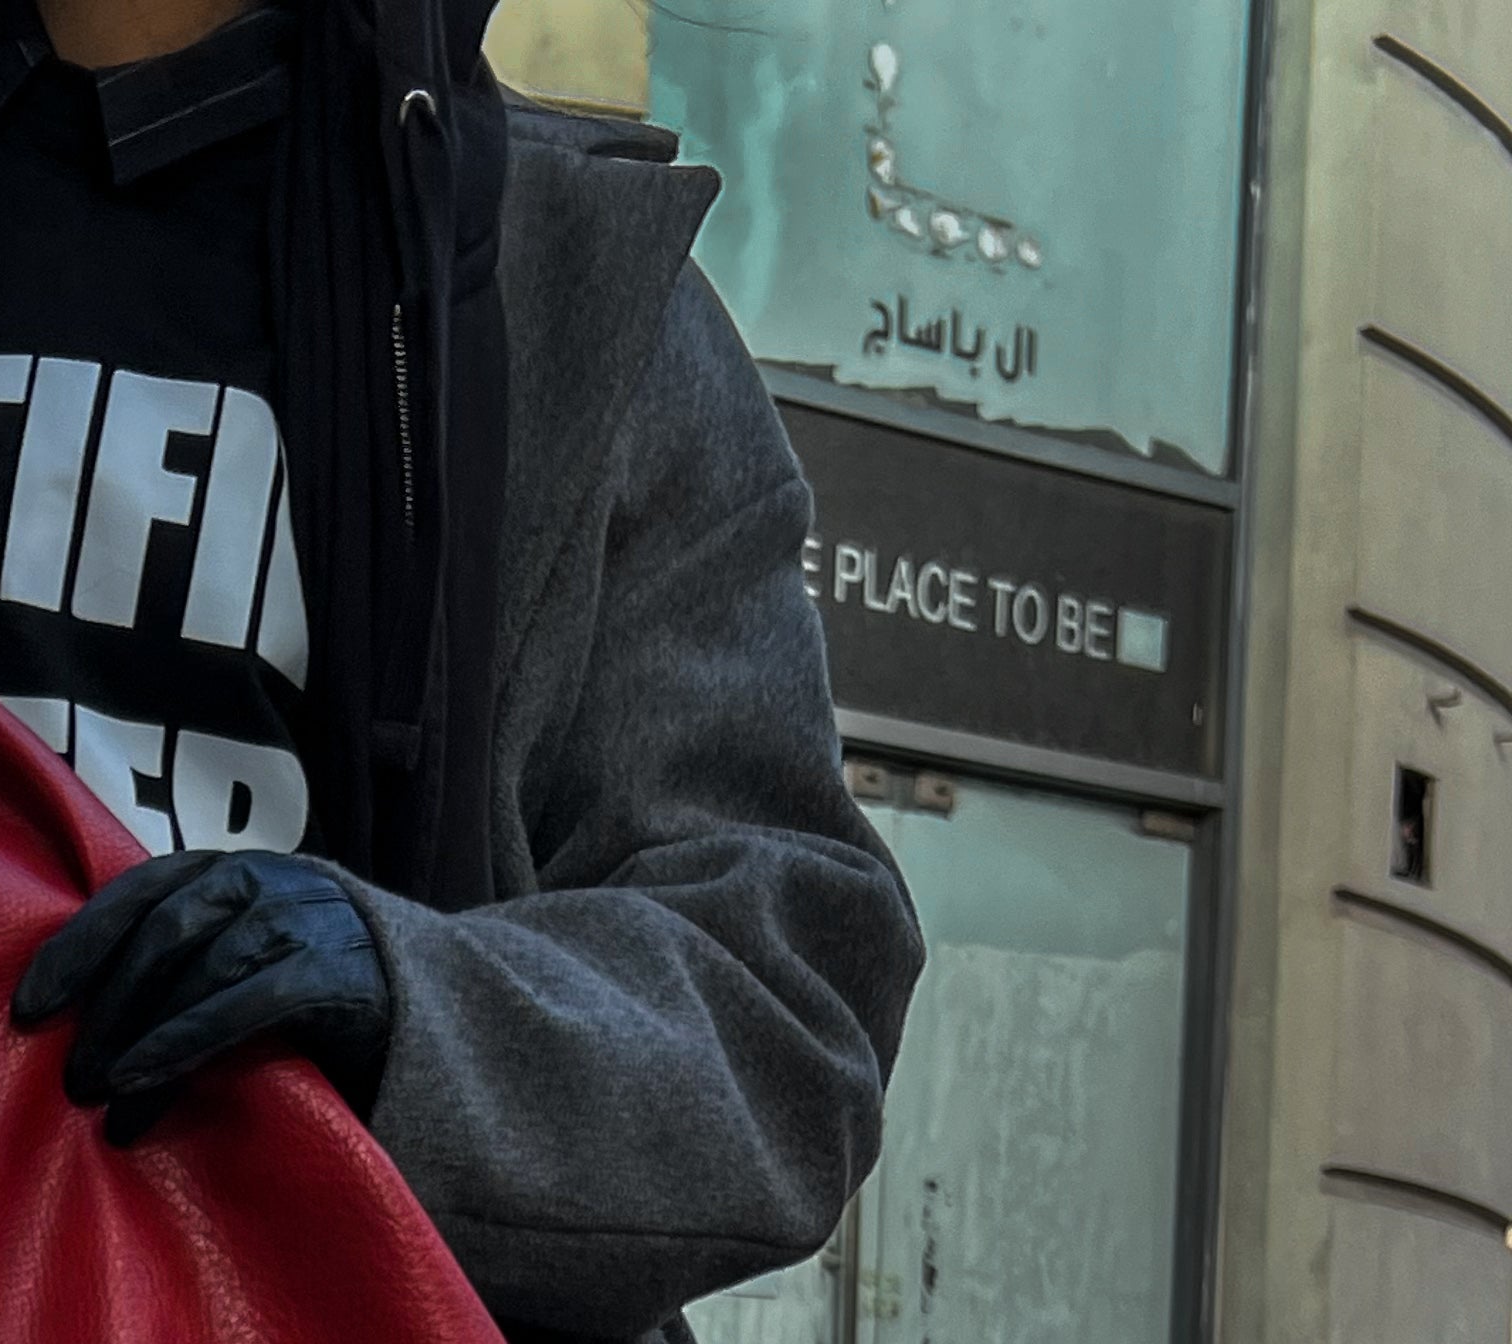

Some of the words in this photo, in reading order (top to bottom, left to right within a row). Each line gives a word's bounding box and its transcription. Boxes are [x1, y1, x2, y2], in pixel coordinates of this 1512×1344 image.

[835, 543, 979, 633] PLACE
[988, 576, 1050, 646] TO
[1055, 592, 1114, 662] BE
